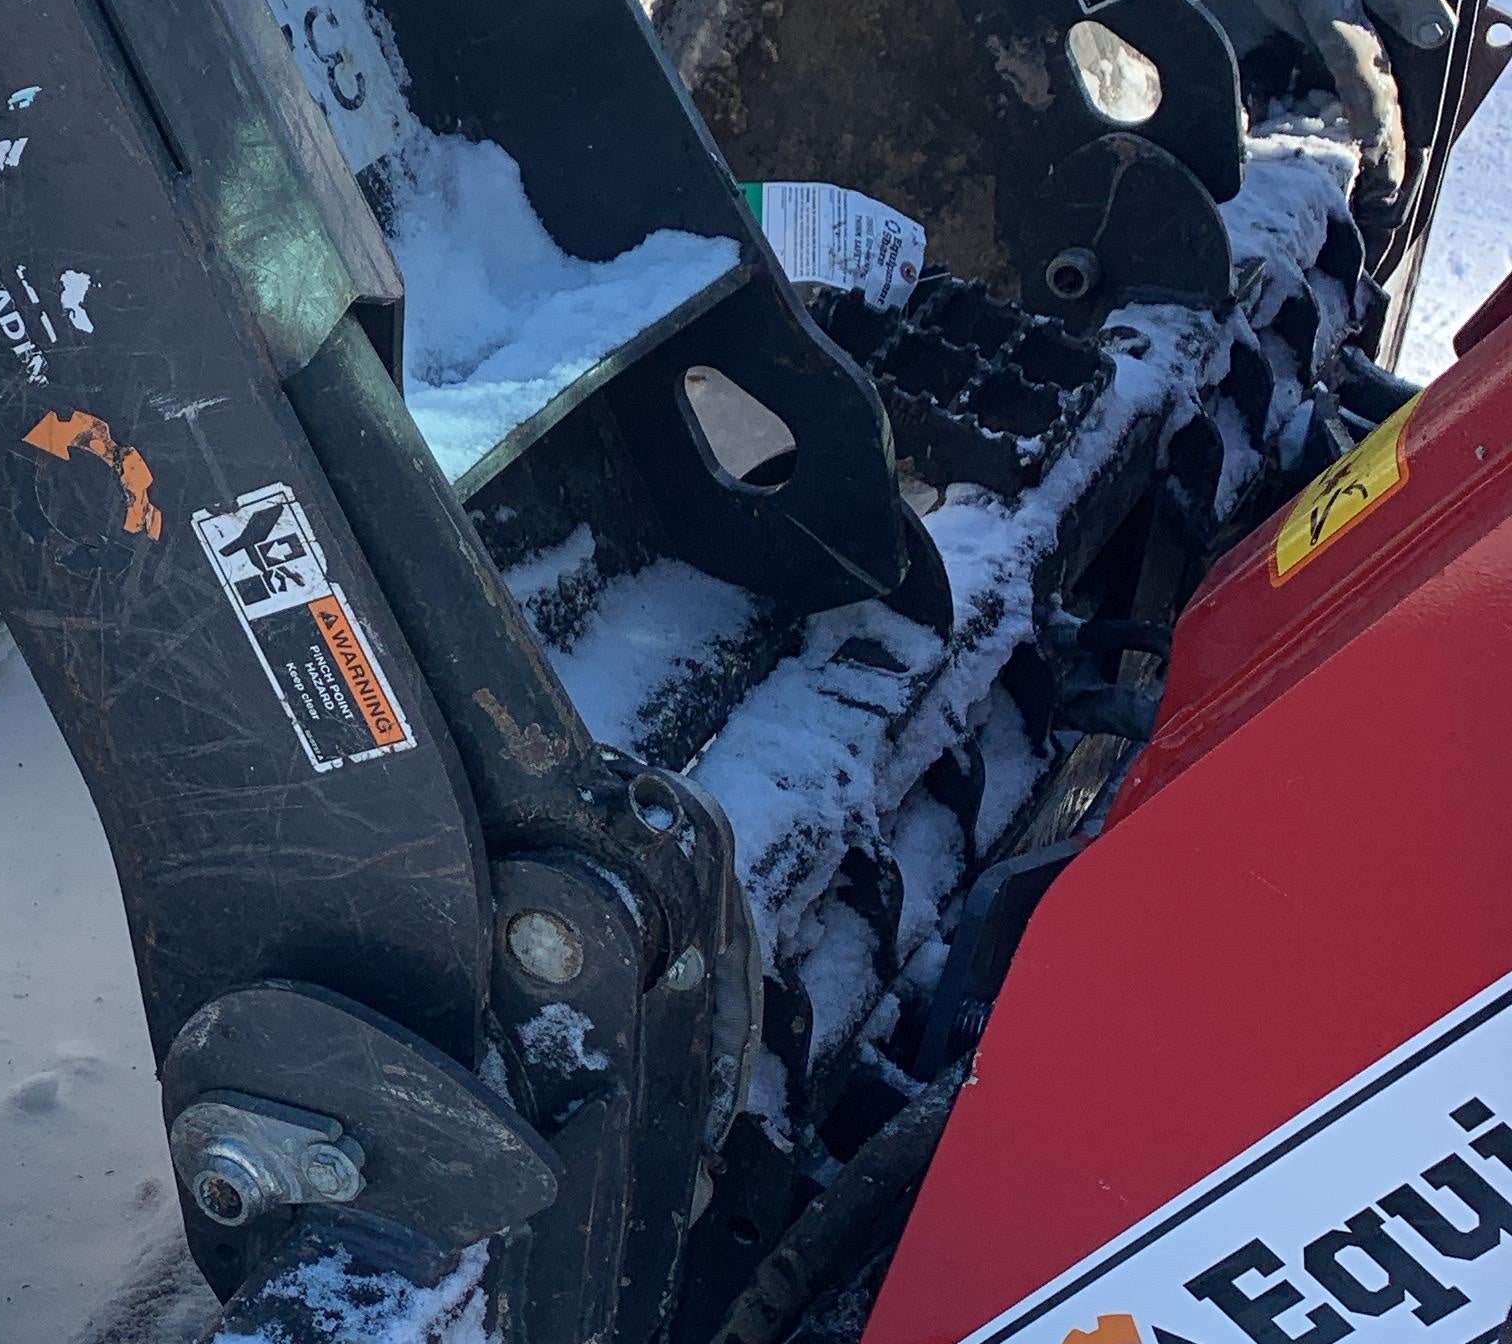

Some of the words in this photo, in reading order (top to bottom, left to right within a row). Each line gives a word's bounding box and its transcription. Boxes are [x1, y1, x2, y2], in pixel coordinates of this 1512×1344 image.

[877, 237, 902, 305] Equipment
[878, 231, 890, 267] Share
[283, 661, 307, 693] Keep
[300, 691, 322, 722] clear
[304, 661, 335, 712] HAZARD
[309, 643, 335, 683] PINCH
[329, 683, 354, 721] POINT
[330, 629, 395, 736] WARNING
